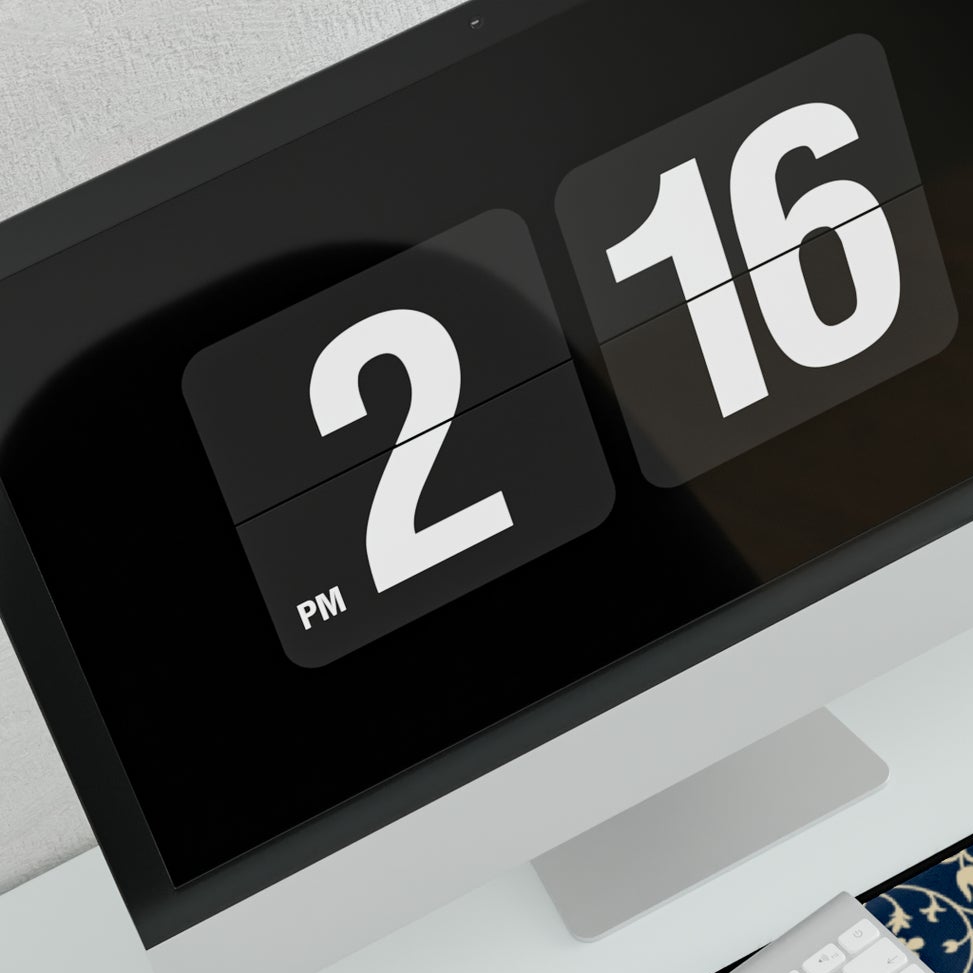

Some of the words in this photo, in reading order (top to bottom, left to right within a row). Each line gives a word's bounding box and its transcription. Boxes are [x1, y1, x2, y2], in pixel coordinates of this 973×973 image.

[310, 309, 514, 594] 2
[605, 102, 901, 419] 16
[296, 585, 347, 631] PM
